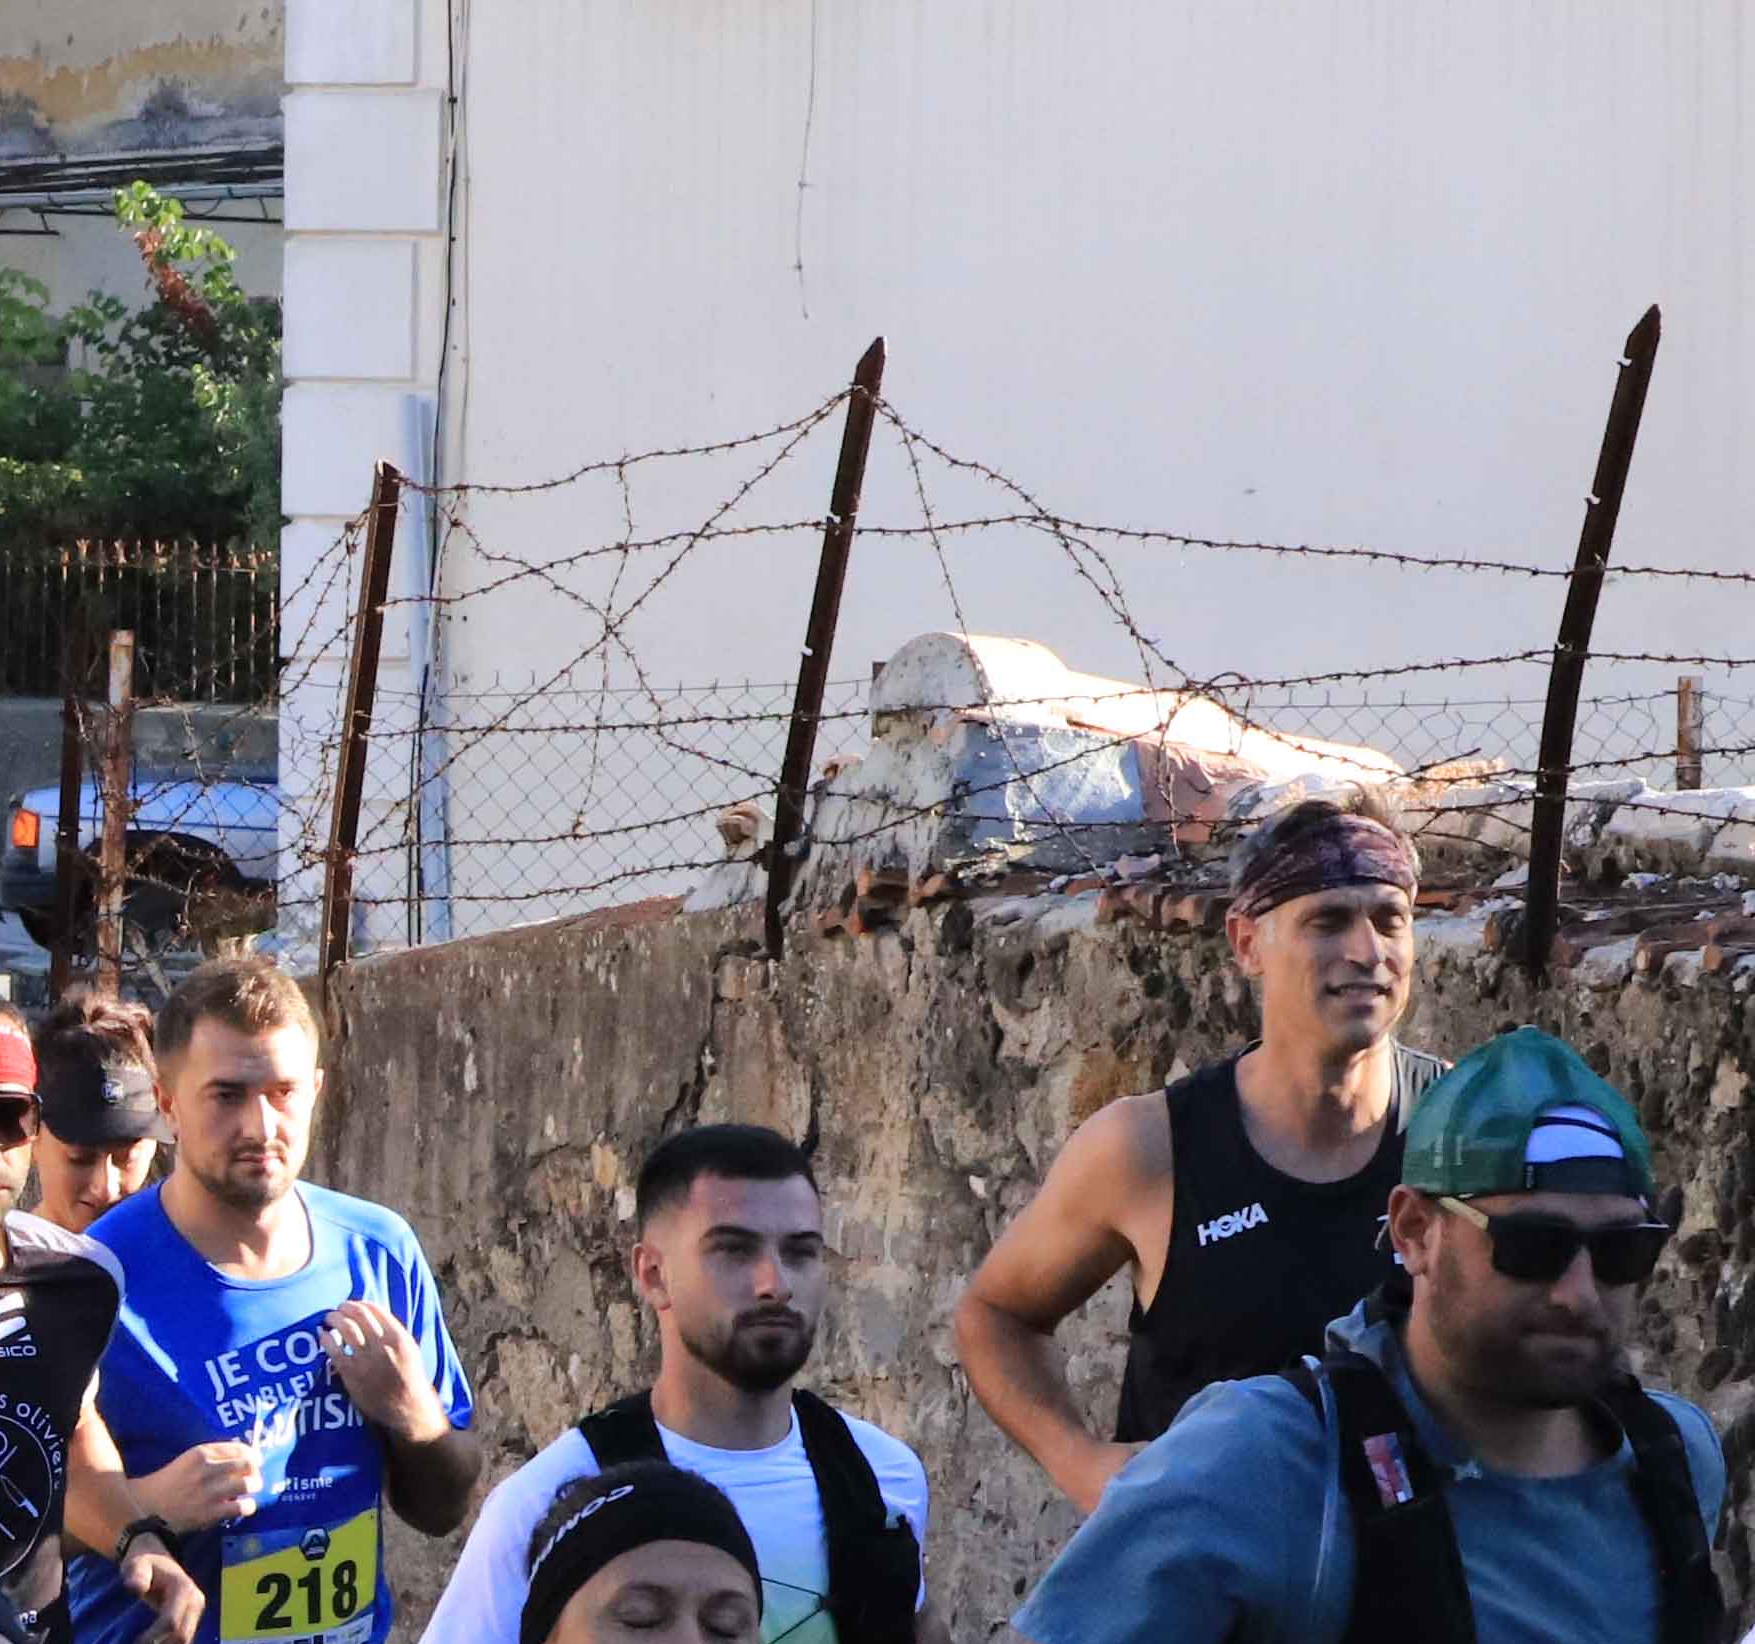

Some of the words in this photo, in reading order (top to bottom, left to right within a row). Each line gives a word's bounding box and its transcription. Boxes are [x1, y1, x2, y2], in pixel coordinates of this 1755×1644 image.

[1197, 1203, 1269, 1246] HOKA
[205, 1350, 250, 1402] JE
[256, 1325, 327, 1373] CO
[255, 1560, 358, 1630] 218
